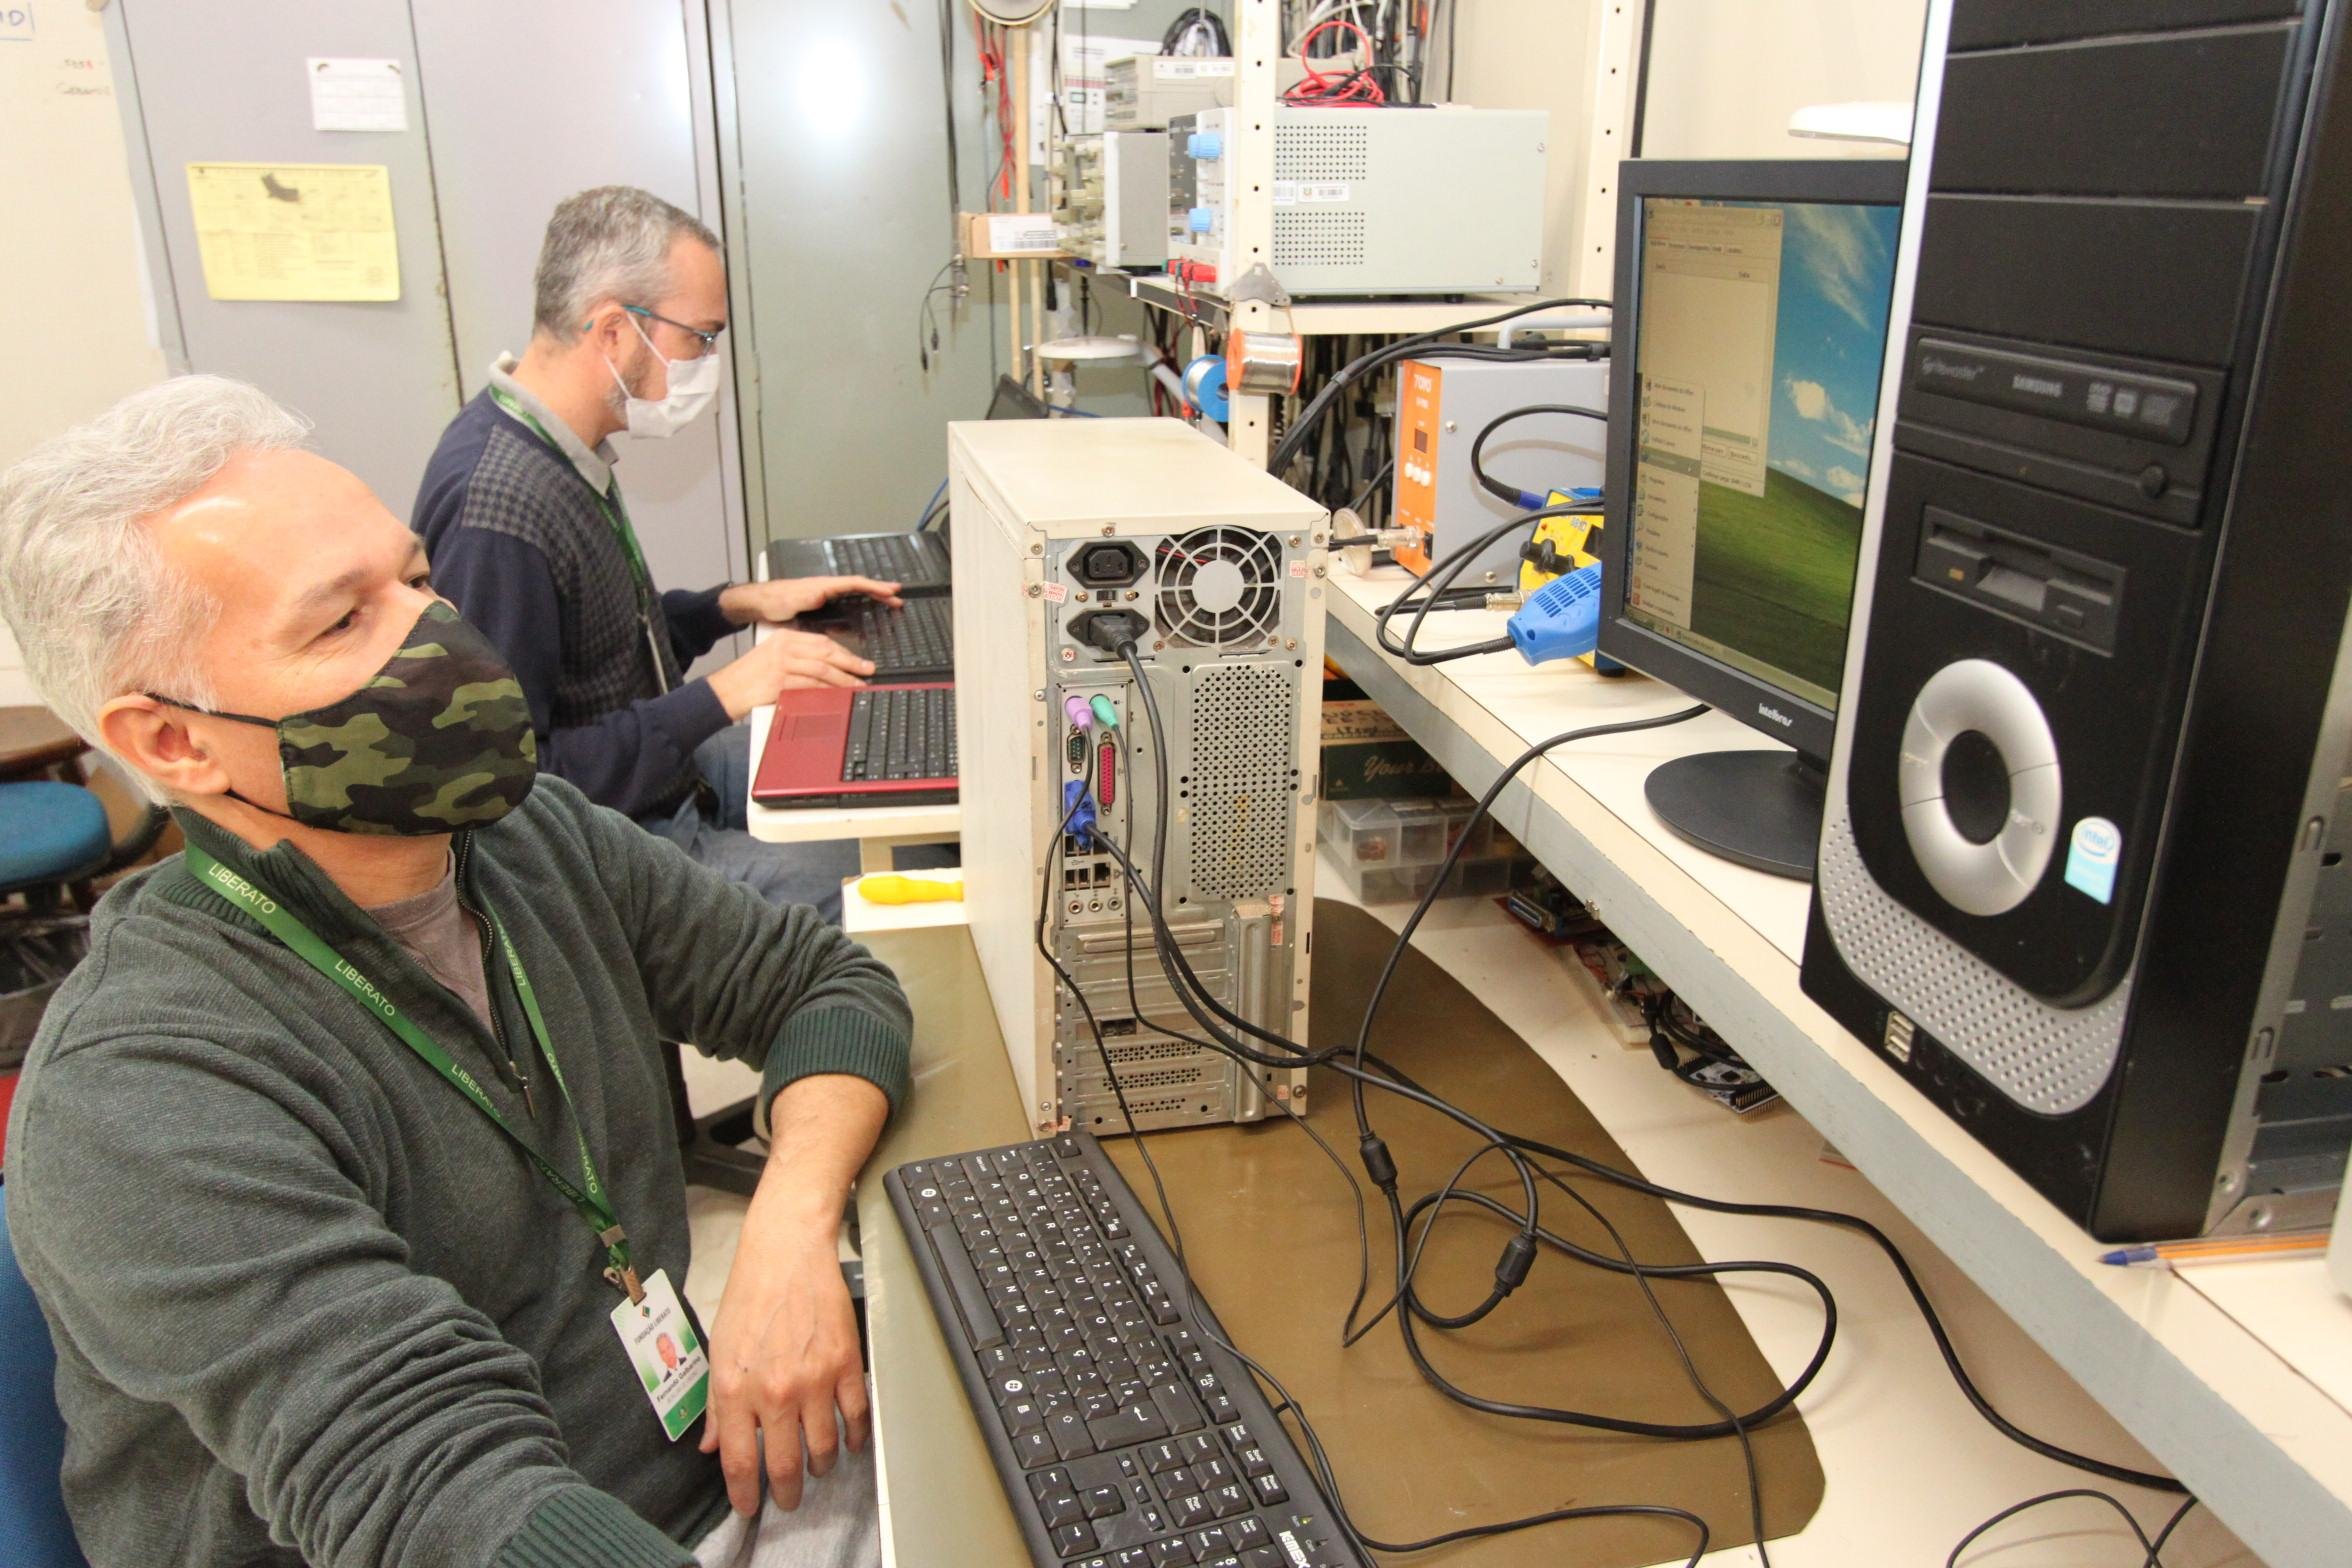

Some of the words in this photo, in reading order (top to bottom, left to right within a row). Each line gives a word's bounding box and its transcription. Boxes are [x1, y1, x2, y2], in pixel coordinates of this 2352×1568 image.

[208, 862, 277, 915] LIBERATO
[334, 959, 396, 1017] LIBERATO
[1174, 1471, 1183, 1480] End
[1211, 1461, 1220, 1474] Home
